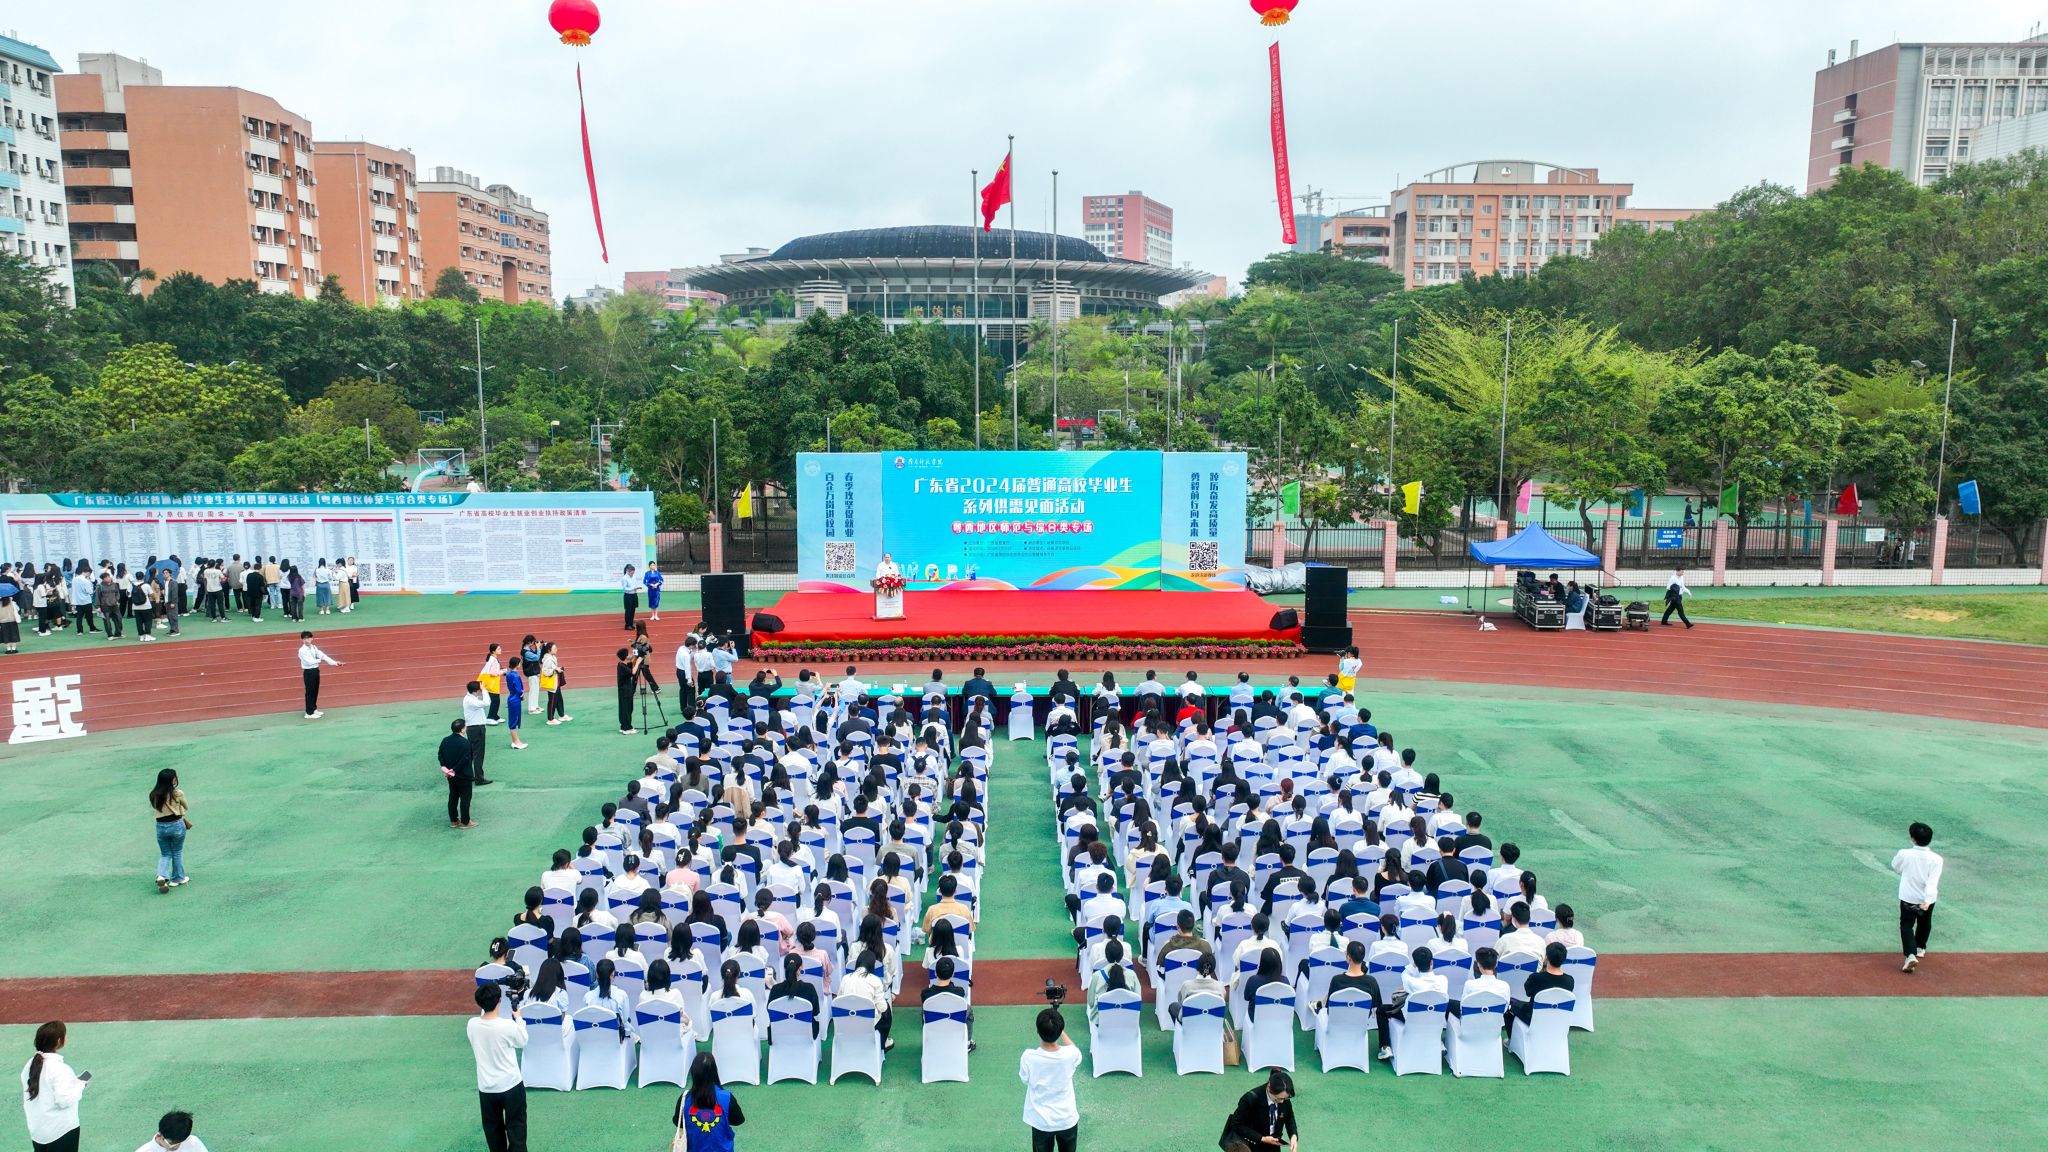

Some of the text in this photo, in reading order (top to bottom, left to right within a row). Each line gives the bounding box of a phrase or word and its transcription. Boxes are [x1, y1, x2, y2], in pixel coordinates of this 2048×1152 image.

[914, 477, 1133, 494] 广东省2024届普通高校毕业生
[963, 498, 1085, 514] 系列供需见面活动
[1190, 472, 1200, 537] 勇毅前行向未来
[952, 521, 1093, 533] 粤西地区师范与综合类专场
